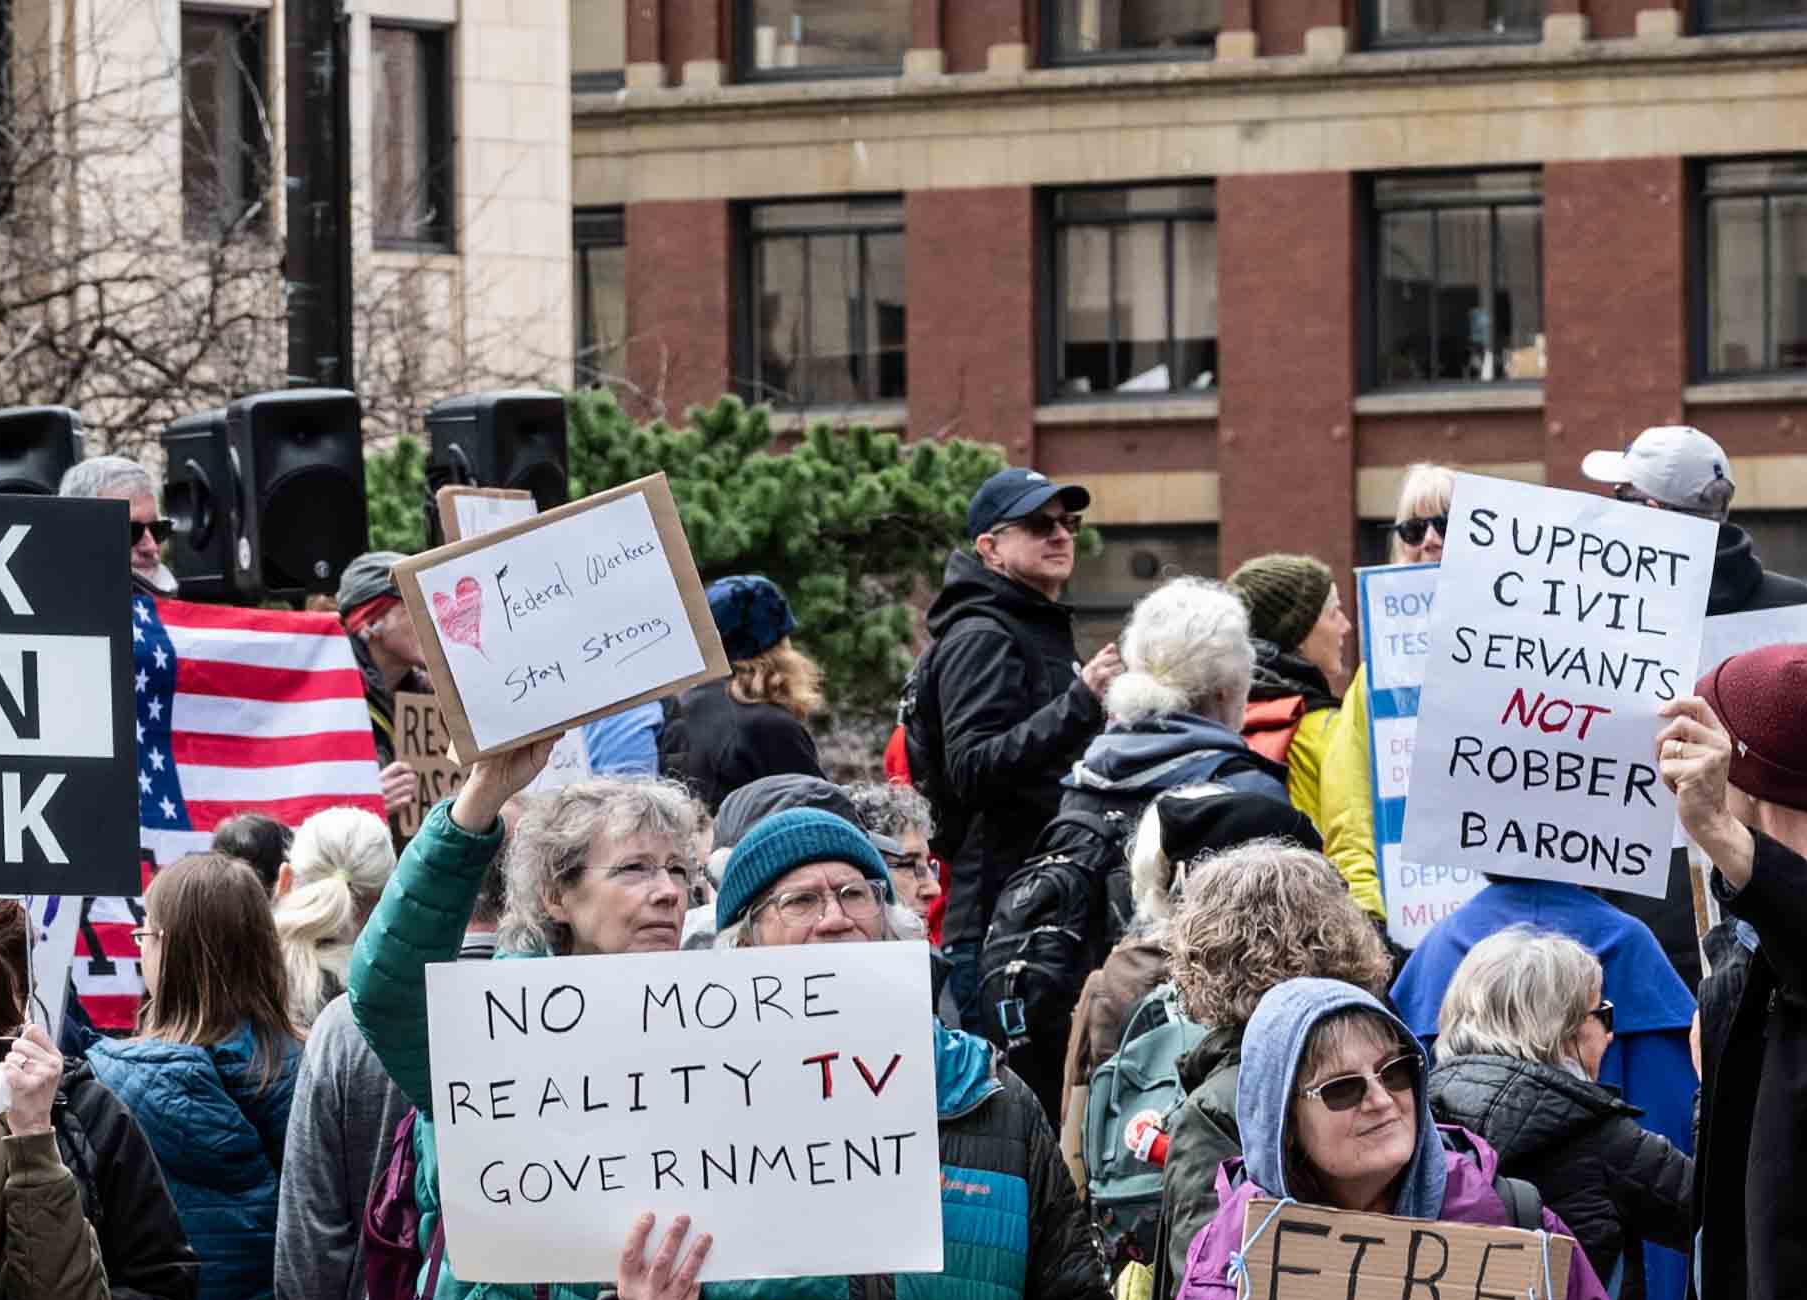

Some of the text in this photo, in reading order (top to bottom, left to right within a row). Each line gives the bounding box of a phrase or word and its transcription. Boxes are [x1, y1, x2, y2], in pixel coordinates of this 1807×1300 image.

[1470, 508, 1690, 586] SUPPORT
[495, 541, 655, 632] Federal Workers
[1494, 571, 1667, 636] CIVIL
[504, 617, 672, 703] Stay Strong
[1451, 626, 1680, 700] SERVANTS
[1501, 687, 1611, 740] NOT
[1449, 735, 1658, 807] ROBBER
[1461, 811, 1652, 876] BARONS
[485, 971, 840, 1042] NO MORE
[448, 1052, 902, 1126] REALITY TV
[479, 1131, 918, 1207] GOVERNMENT
